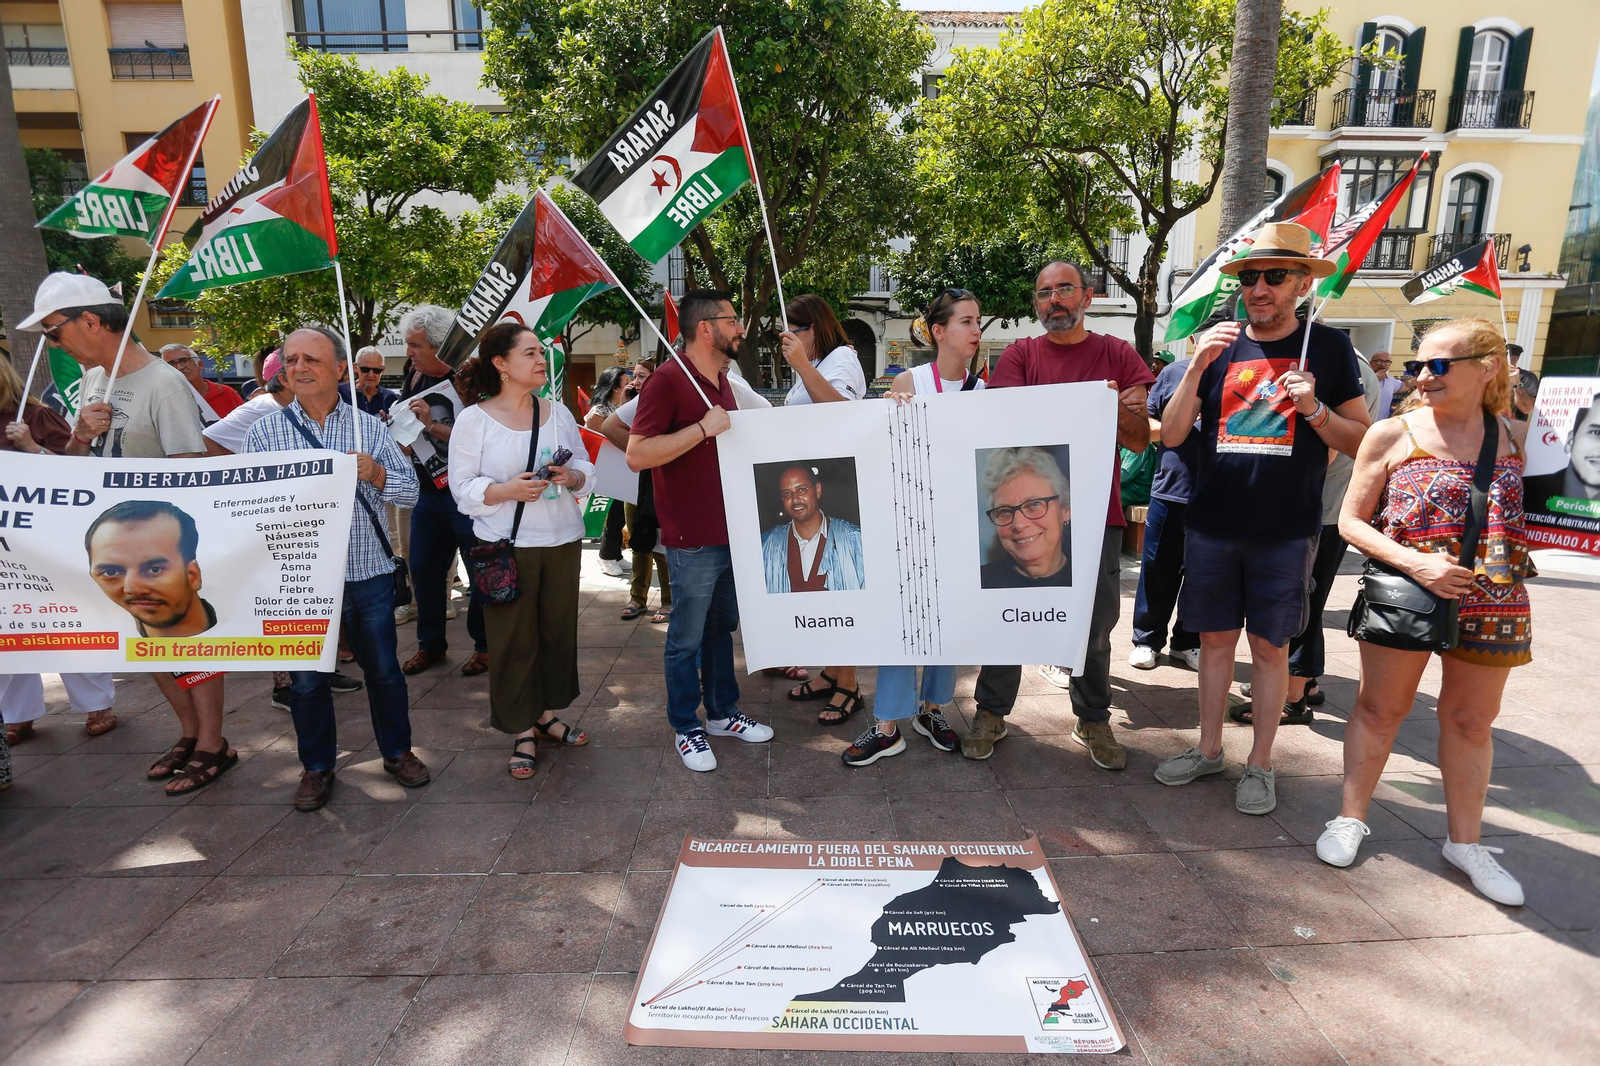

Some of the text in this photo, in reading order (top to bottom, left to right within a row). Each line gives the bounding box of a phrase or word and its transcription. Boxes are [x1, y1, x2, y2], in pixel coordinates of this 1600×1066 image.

[383, 335, 404, 346] Alta
[1542, 386, 1593, 397] LIBERAR A
[1541, 397, 1590, 407] MOHAMED
[1538, 409, 1569, 417] LAMIN
[1537, 418, 1566, 427] HADDI
[110, 459, 328, 487] LIBERTAD PARA HADDI
[213, 493, 296, 509] Enfermedades y
[230, 502, 339, 518] secuelas de tortura:
[255, 518, 325, 532] Semi-ciego
[1556, 516, 1600, 531] ARBITRARIA
[265, 530, 319, 542] Náuseas
[267, 540, 320, 551] Enuresis
[1581, 537, 1590, 550] A
[272, 551, 317, 562] Espalda
[280, 562, 312, 571] Asma
[24, 572, 49, 583] una
[281, 573, 311, 583] Dolor
[279, 585, 314, 594] Fiebre
[255, 596, 283, 605] Dolor
[286, 596, 300, 605] de
[12, 603, 33, 615] 25
[38, 602, 79, 614] años
[254, 607, 301, 617] Infección
[304, 607, 318, 616] de
[794, 613, 854, 629] Naama
[1001, 608, 1067, 623] Claude
[9, 620, 82, 629] de su casa
[22, 633, 115, 646] aislamiento
[135, 641, 166, 657] Sin
[172, 641, 274, 657] tratamiento
[689, 840, 813, 854] ENCARCELAMIENTO
[817, 844, 860, 855] FUERA
[864, 844, 889, 855] DEL
[893, 844, 947, 855] SAHARA
[808, 856, 914, 867] LA DOBLE PENA
[888, 921, 995, 936] MARRUECOS
[681, 1013, 714, 1021] ocupado
[771, 1016, 919, 1031] SAHARA OCCIDENTAL
